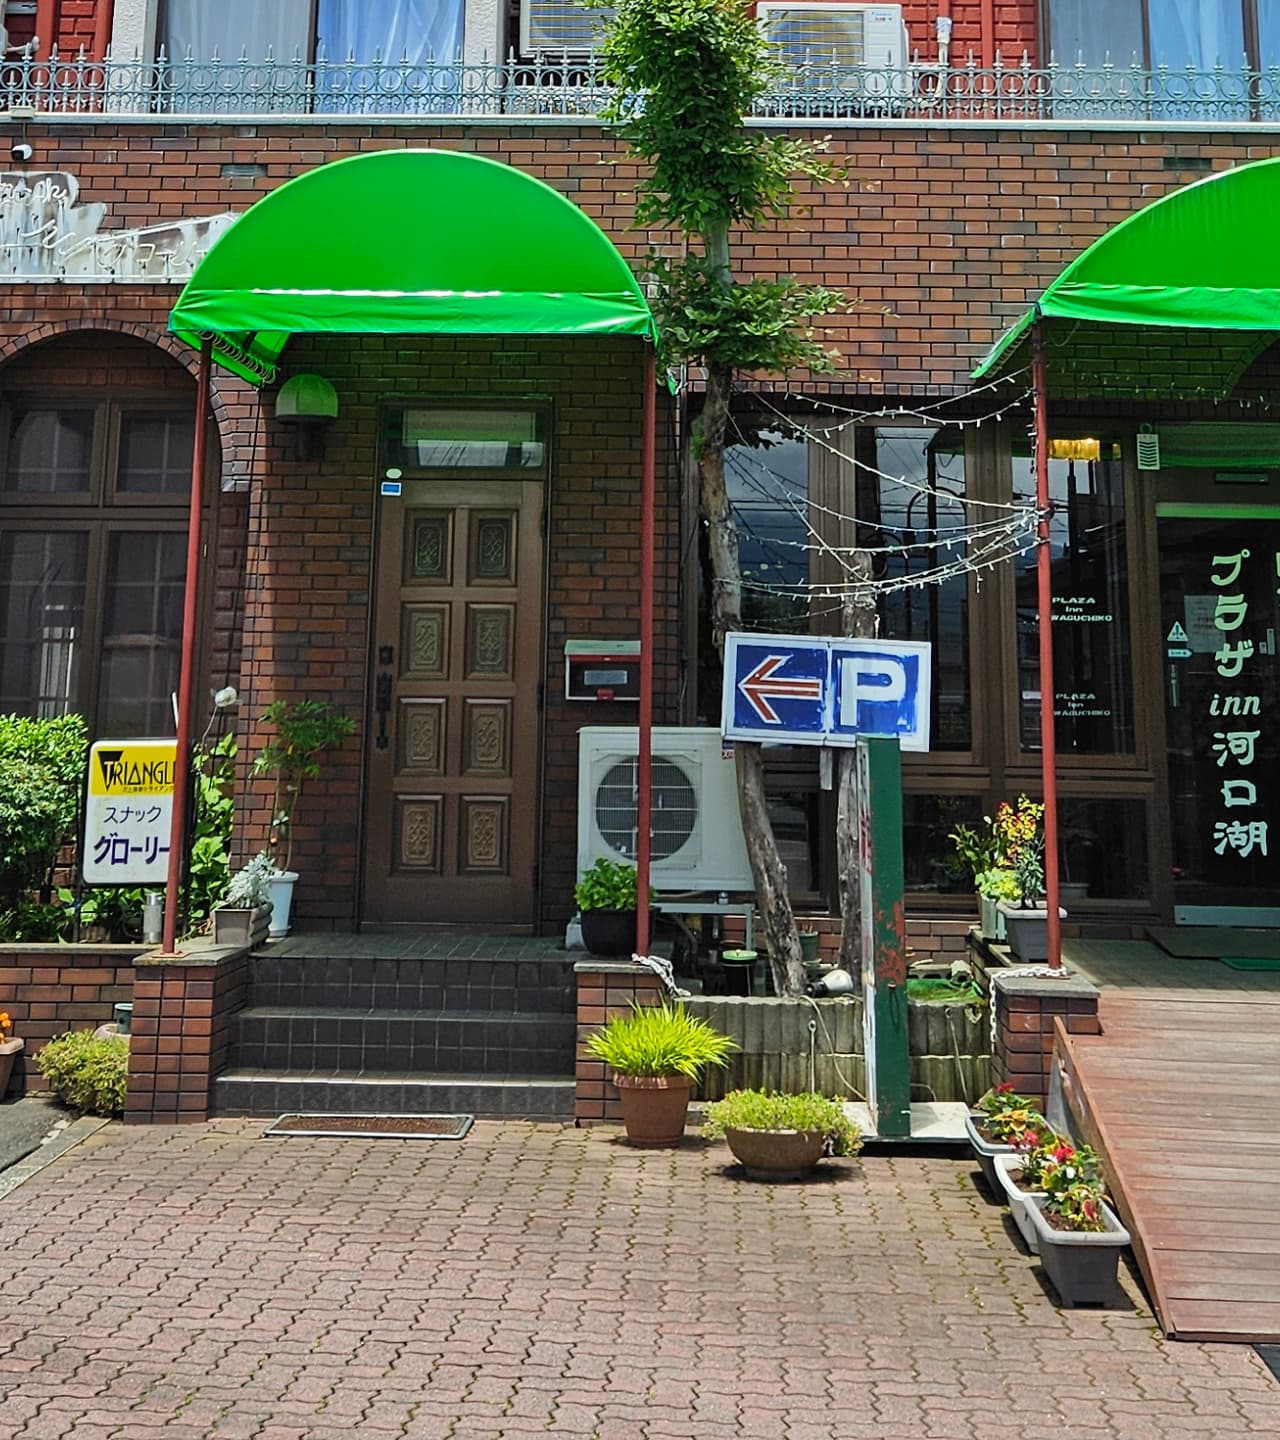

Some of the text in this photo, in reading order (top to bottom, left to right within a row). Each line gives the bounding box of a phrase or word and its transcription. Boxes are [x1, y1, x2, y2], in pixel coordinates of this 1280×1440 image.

[838, 656, 907, 727] P
[1209, 548, 1268, 858] プラザ inn 河口湖
[103, 805, 162, 824] スナック
